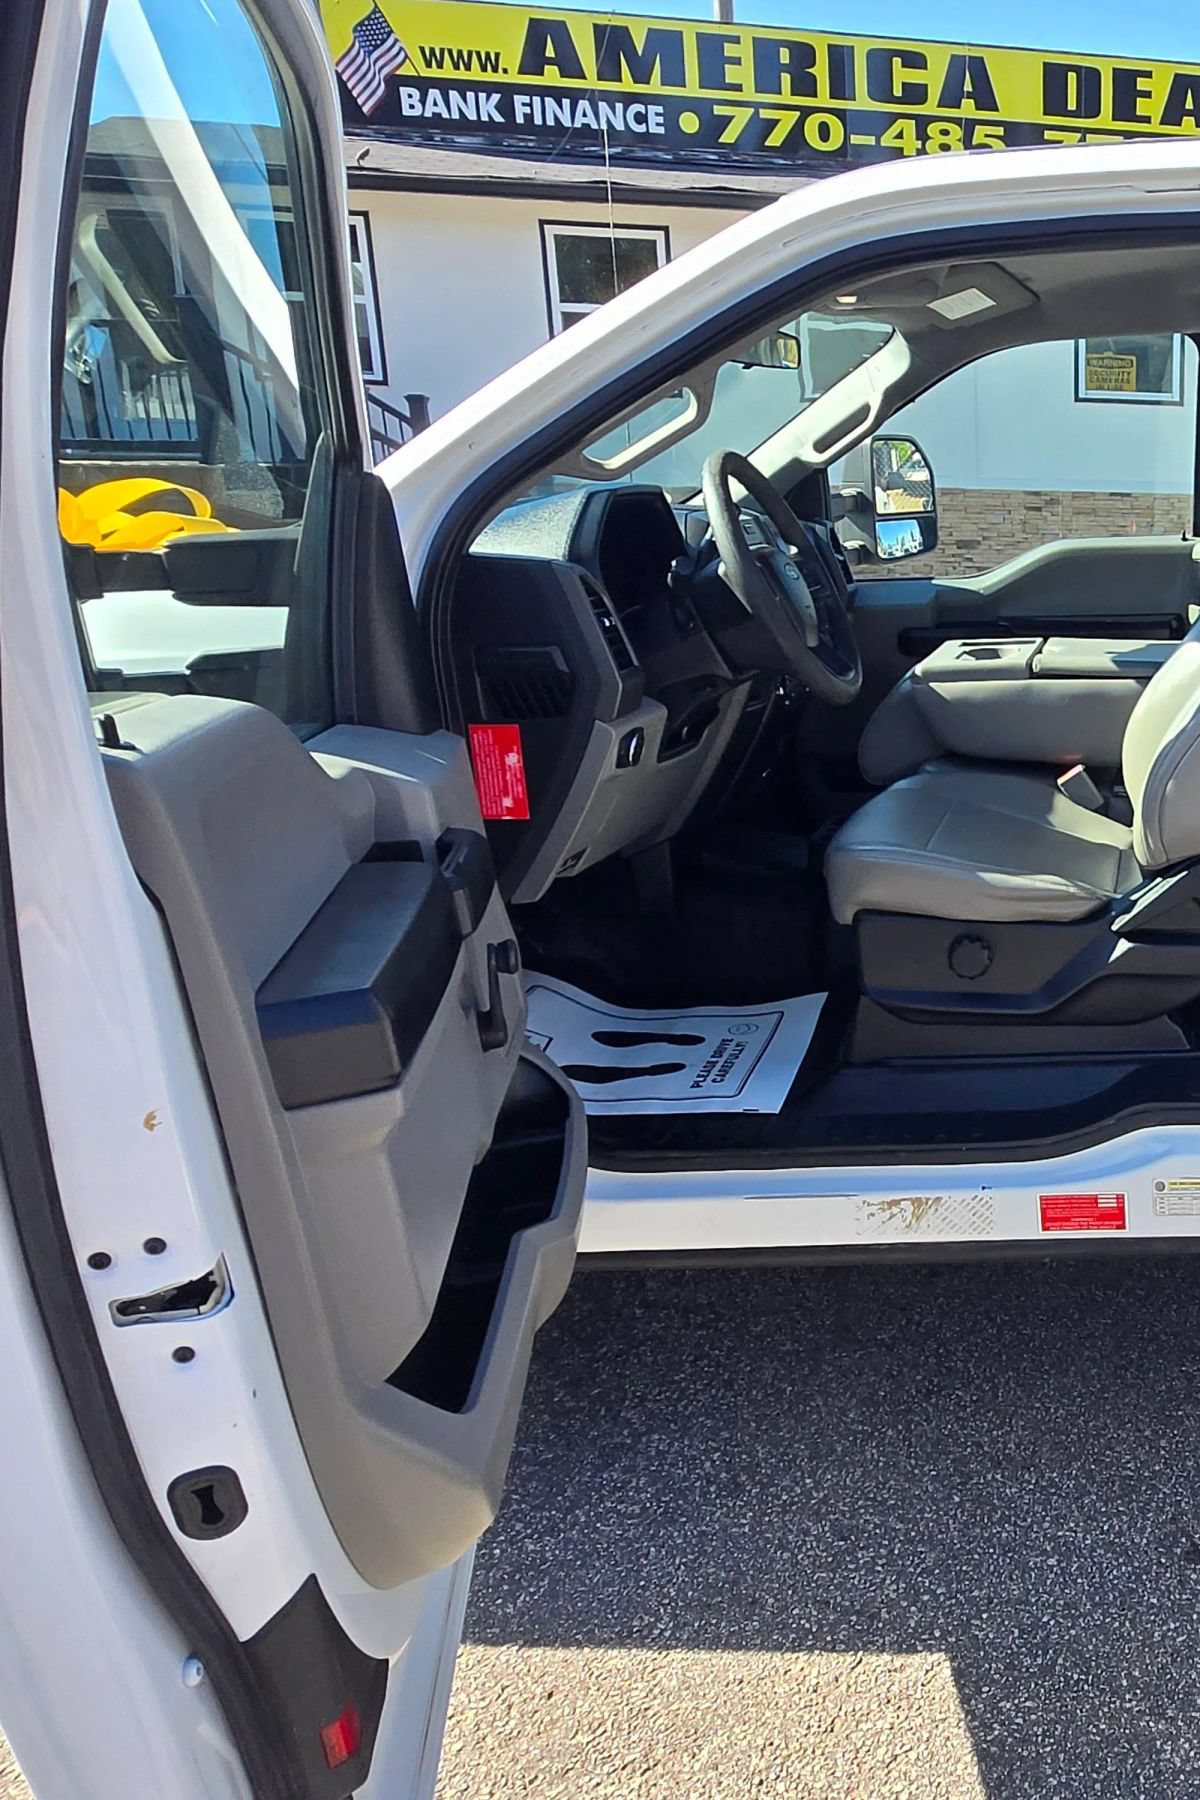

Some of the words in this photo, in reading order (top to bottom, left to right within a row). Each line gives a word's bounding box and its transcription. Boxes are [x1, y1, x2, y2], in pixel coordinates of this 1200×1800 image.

[517, 17, 999, 112] AMERICA
[399, 86, 505, 123] BANK
[513, 94, 665, 134] FINANCE
[689, 1060, 719, 1089] PLEASE
[709, 1038, 734, 1059] DRIVE
